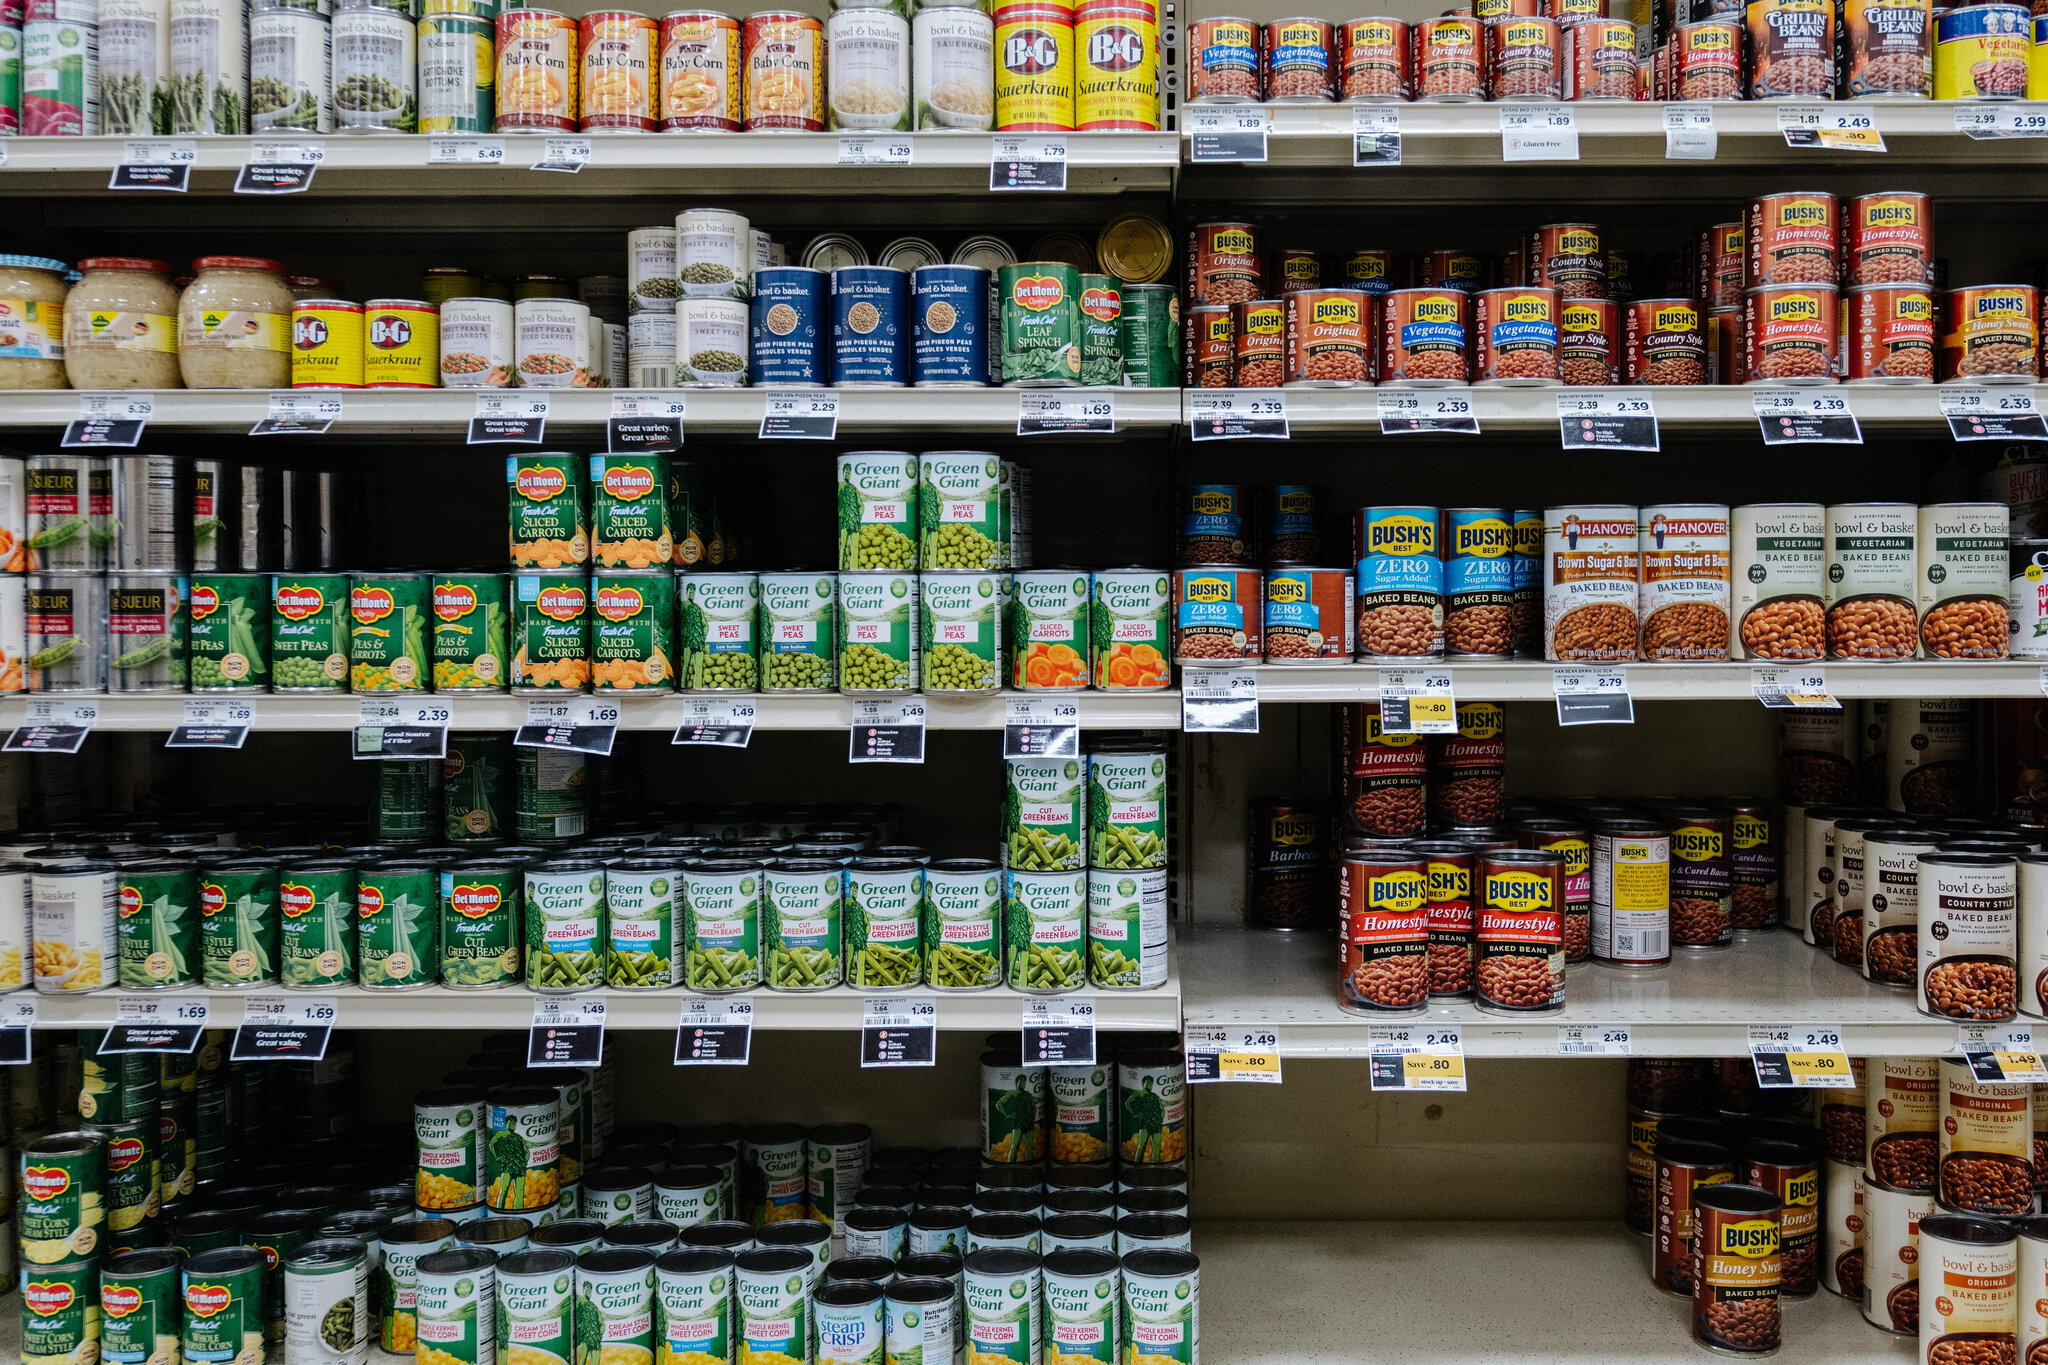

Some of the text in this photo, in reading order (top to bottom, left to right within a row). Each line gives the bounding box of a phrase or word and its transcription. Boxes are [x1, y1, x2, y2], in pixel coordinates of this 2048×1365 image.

[1764, 11, 1828, 26] GRILLIN'
[1216, 28, 1249, 42] BUSH'S
[1507, 27, 1544, 41] BUSH'S
[1778, 22, 1824, 38] BEANS
[837, 41, 896, 52] SAUERKRAUT
[1090, 30, 1142, 64] B&G
[1694, 32, 1729, 50] BUSH'S
[1006, 34, 1058, 67] B&G
[1499, 46, 1552, 59] Country Style
[1687, 50, 1736, 64] Homestyle
[506, 52, 564, 70] Baby Corn
[587, 54, 645, 70] Baby Corn
[996, 79, 1070, 99] Sauerkraut
[1078, 79, 1153, 97] Sauerkraut
[1238, 119, 1260, 128] 1.89
[1800, 115, 1820, 124] 1.81
[1838, 117, 1870, 129] 2.49
[2014, 116, 2046, 128] 2.99
[1784, 207, 1824, 220] BUSH'S
[1776, 229, 1830, 242] Homestyle
[1017, 286, 1063, 297] Del Monte
[1317, 303, 1356, 318] BUSH'S
[1418, 302, 1457, 318] BUSH'S
[1978, 297, 2023, 312] BUSH'S
[1659, 313, 1696, 326] BUSH'S
[1972, 320, 2030, 332] Honey Sweet
[1027, 327, 1052, 337] LEAF
[1314, 325, 1359, 338] Original
[1018, 337, 1061, 348] SPINACH
[1647, 334, 1702, 346] Country Style
[1082, 404, 1111, 415] 1.69
[1251, 403, 1283, 414] 2.39
[1813, 401, 1844, 410] 2.39
[854, 462, 900, 476] Green
[519, 477, 562, 487] Del Monte
[859, 476, 901, 489] Giant
[523, 517, 558, 527] SLICED
[519, 527, 565, 538] CARROTS
[1373, 525, 1432, 546] BUSH'S
[1582, 523, 1634, 536] HANOVER
[699, 583, 744, 596] Green
[1022, 582, 1067, 594] Green
[1190, 581, 1231, 596] BUSH'S
[704, 597, 744, 609] Giant
[1028, 595, 1068, 608] Giant
[1366, 594, 1435, 605] BAKED BEANS
[1599, 677, 1622, 687] 2.79
[589, 709, 618, 720] 1.69
[1102, 764, 1146, 777] Green
[1107, 778, 1147, 790] Giant
[538, 882, 583, 895] Green
[861, 883, 906, 896] Green
[1489, 880, 1549, 901] BUSH'S
[543, 896, 583, 909] Giant
[866, 897, 907, 909] Giant
[1482, 914, 1555, 932] Homestyle
[1948, 913, 1978, 922] BAKED
[465, 937, 484, 948] CUT
[448, 945, 505, 957] GREEN BEANS
[305, 1007, 333, 1019] 1.69
[1244, 1034, 1275, 1046] 2.49
[1807, 1033, 1838, 1045] 2.49
[1956, 1110, 1988, 1121] BAKED
[1726, 1229, 1779, 1245] BUSH'S
[1712, 1261, 1757, 1275] Honey
[503, 1284, 547, 1296] Green
[1047, 1283, 1088, 1297] Green
[26, 1292, 69, 1303] Del Monte
[508, 1297, 548, 1309] Giant
[1051, 1298, 1089, 1311] Giant
[514, 1324, 534, 1334] CREAM
[821, 1320, 865, 1332] steam
[822, 1333, 864, 1345] CRISP
